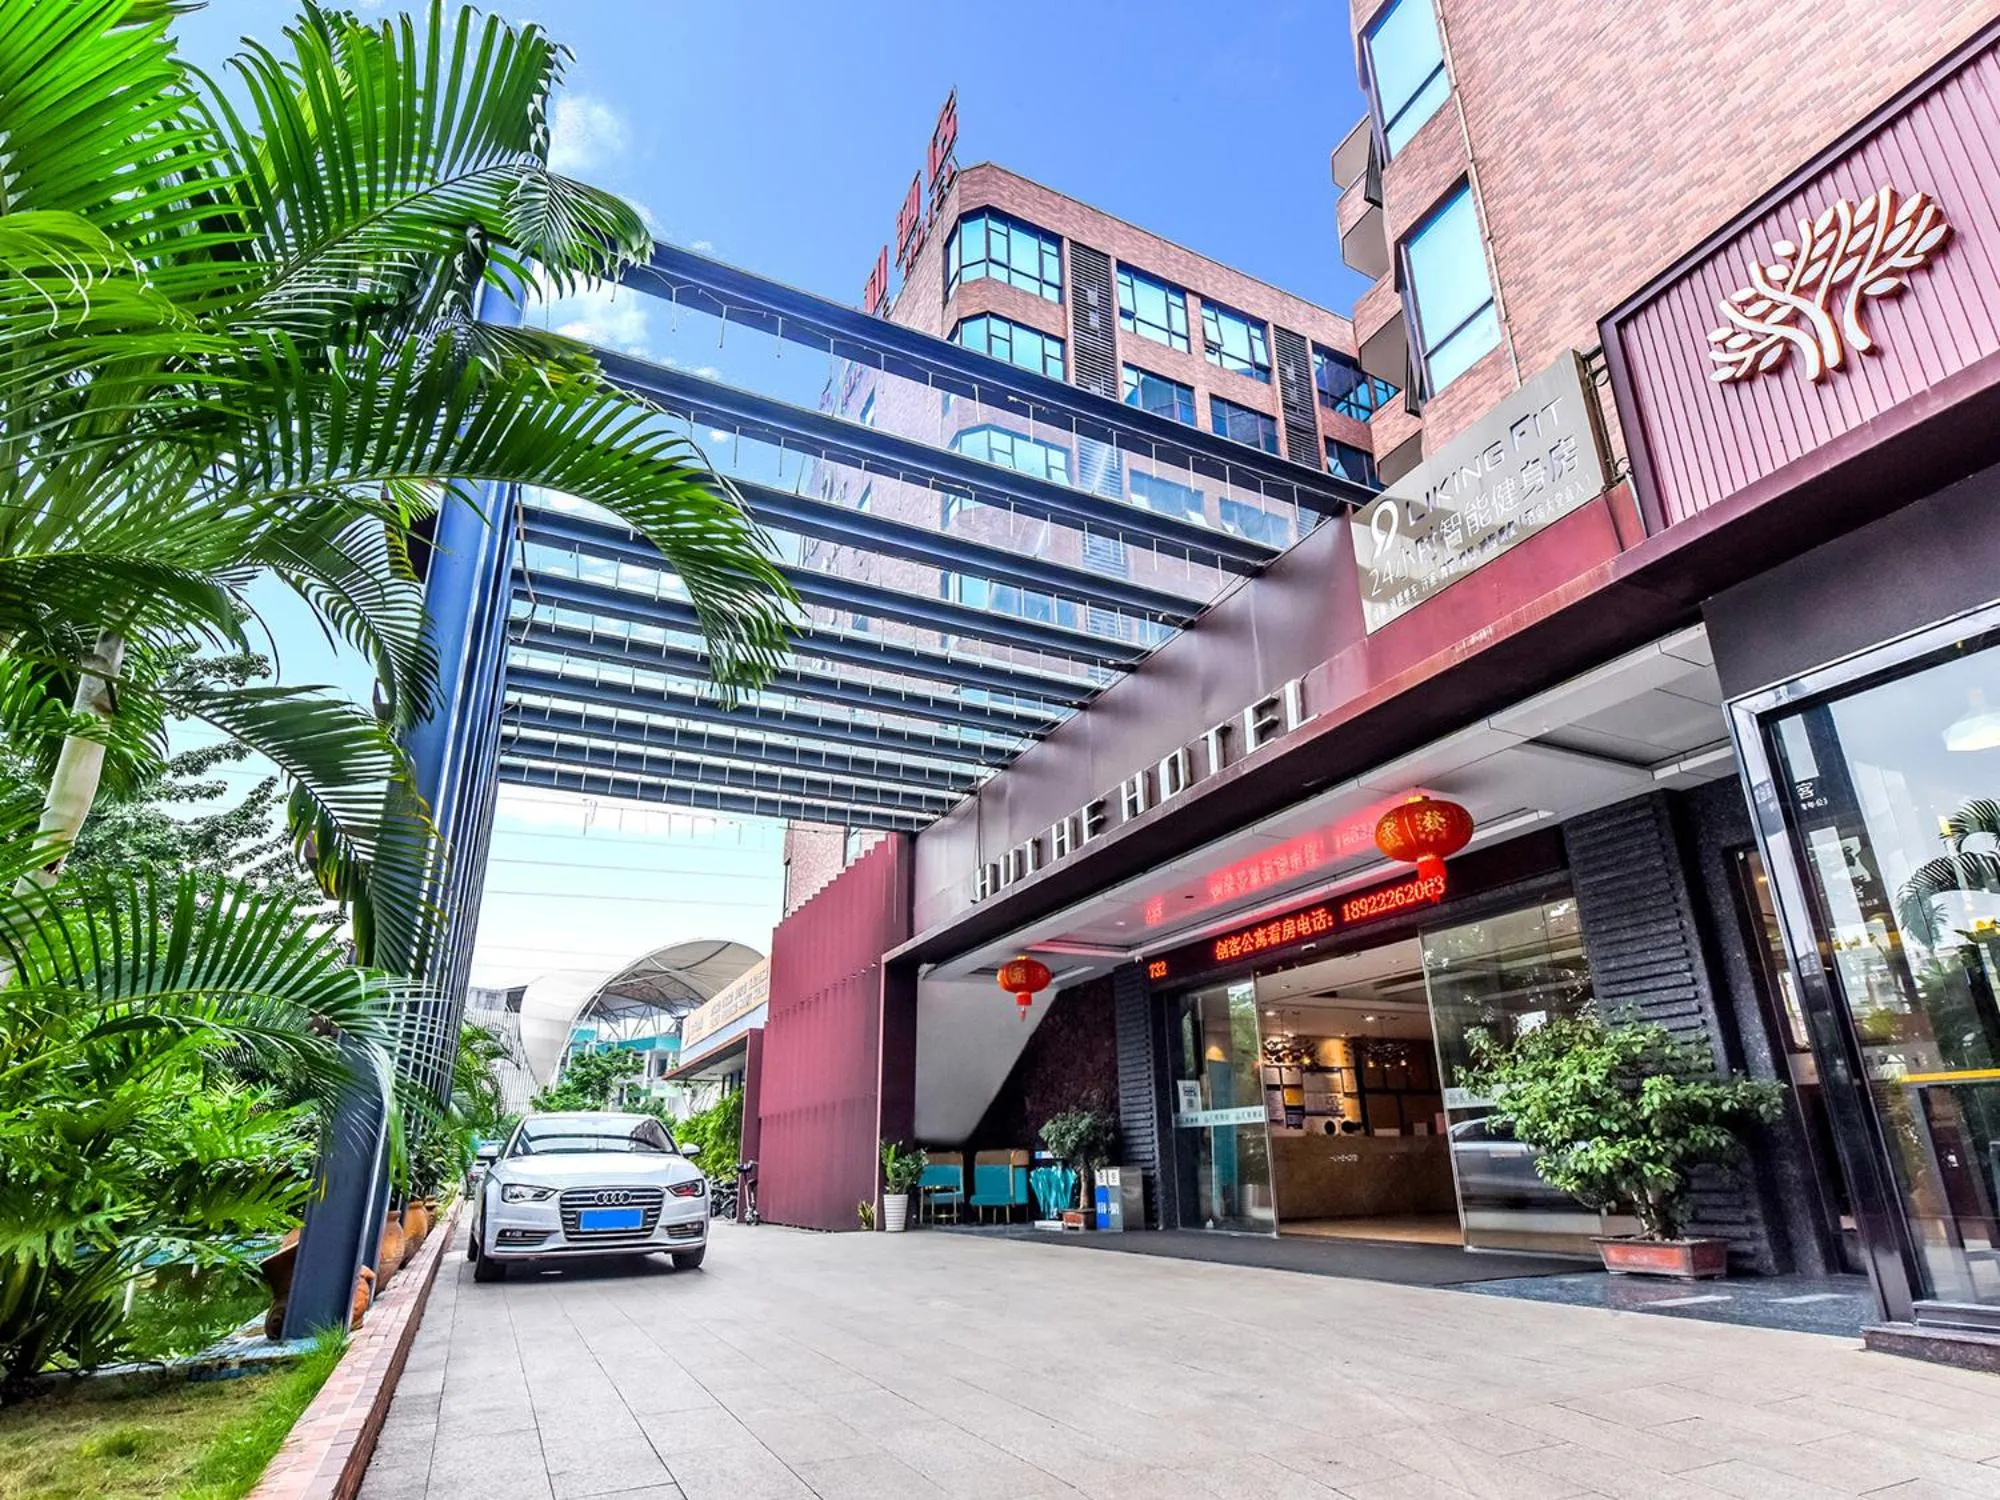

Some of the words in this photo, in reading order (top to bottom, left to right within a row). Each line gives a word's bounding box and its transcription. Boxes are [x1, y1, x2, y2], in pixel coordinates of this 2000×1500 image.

[1406, 440, 1504, 527] LIKING
[1509, 397, 1563, 453] FIT
[976, 837, 1040, 902] HUI
[1051, 798, 1104, 861] HE
[1121, 679, 1321, 822] HOTEL
